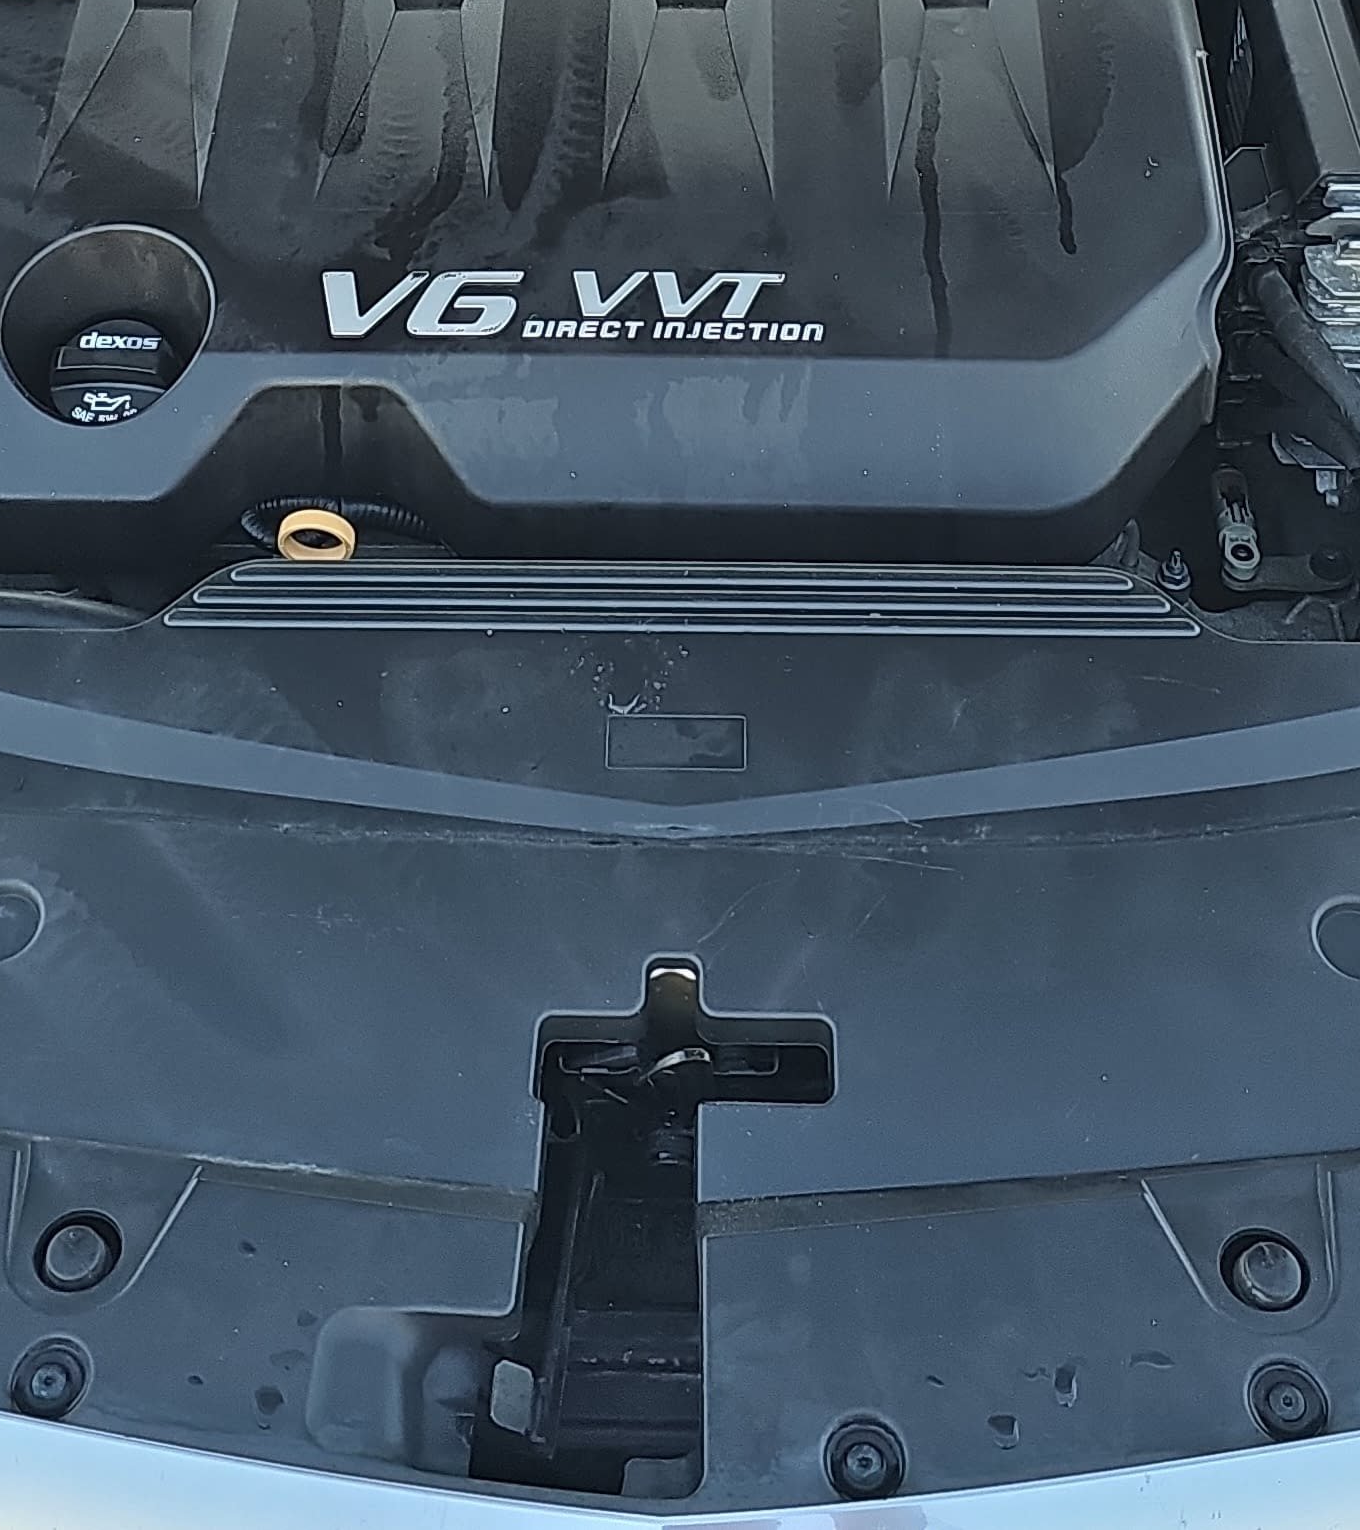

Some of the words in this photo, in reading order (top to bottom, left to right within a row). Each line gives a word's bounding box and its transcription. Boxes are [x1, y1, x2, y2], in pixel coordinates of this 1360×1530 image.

[323, 270, 525, 338] V6
[573, 270, 786, 319] VVT
[80, 331, 162, 350] dexos
[523, 320, 645, 339] DIRECT
[652, 320, 824, 341] INJECTION
